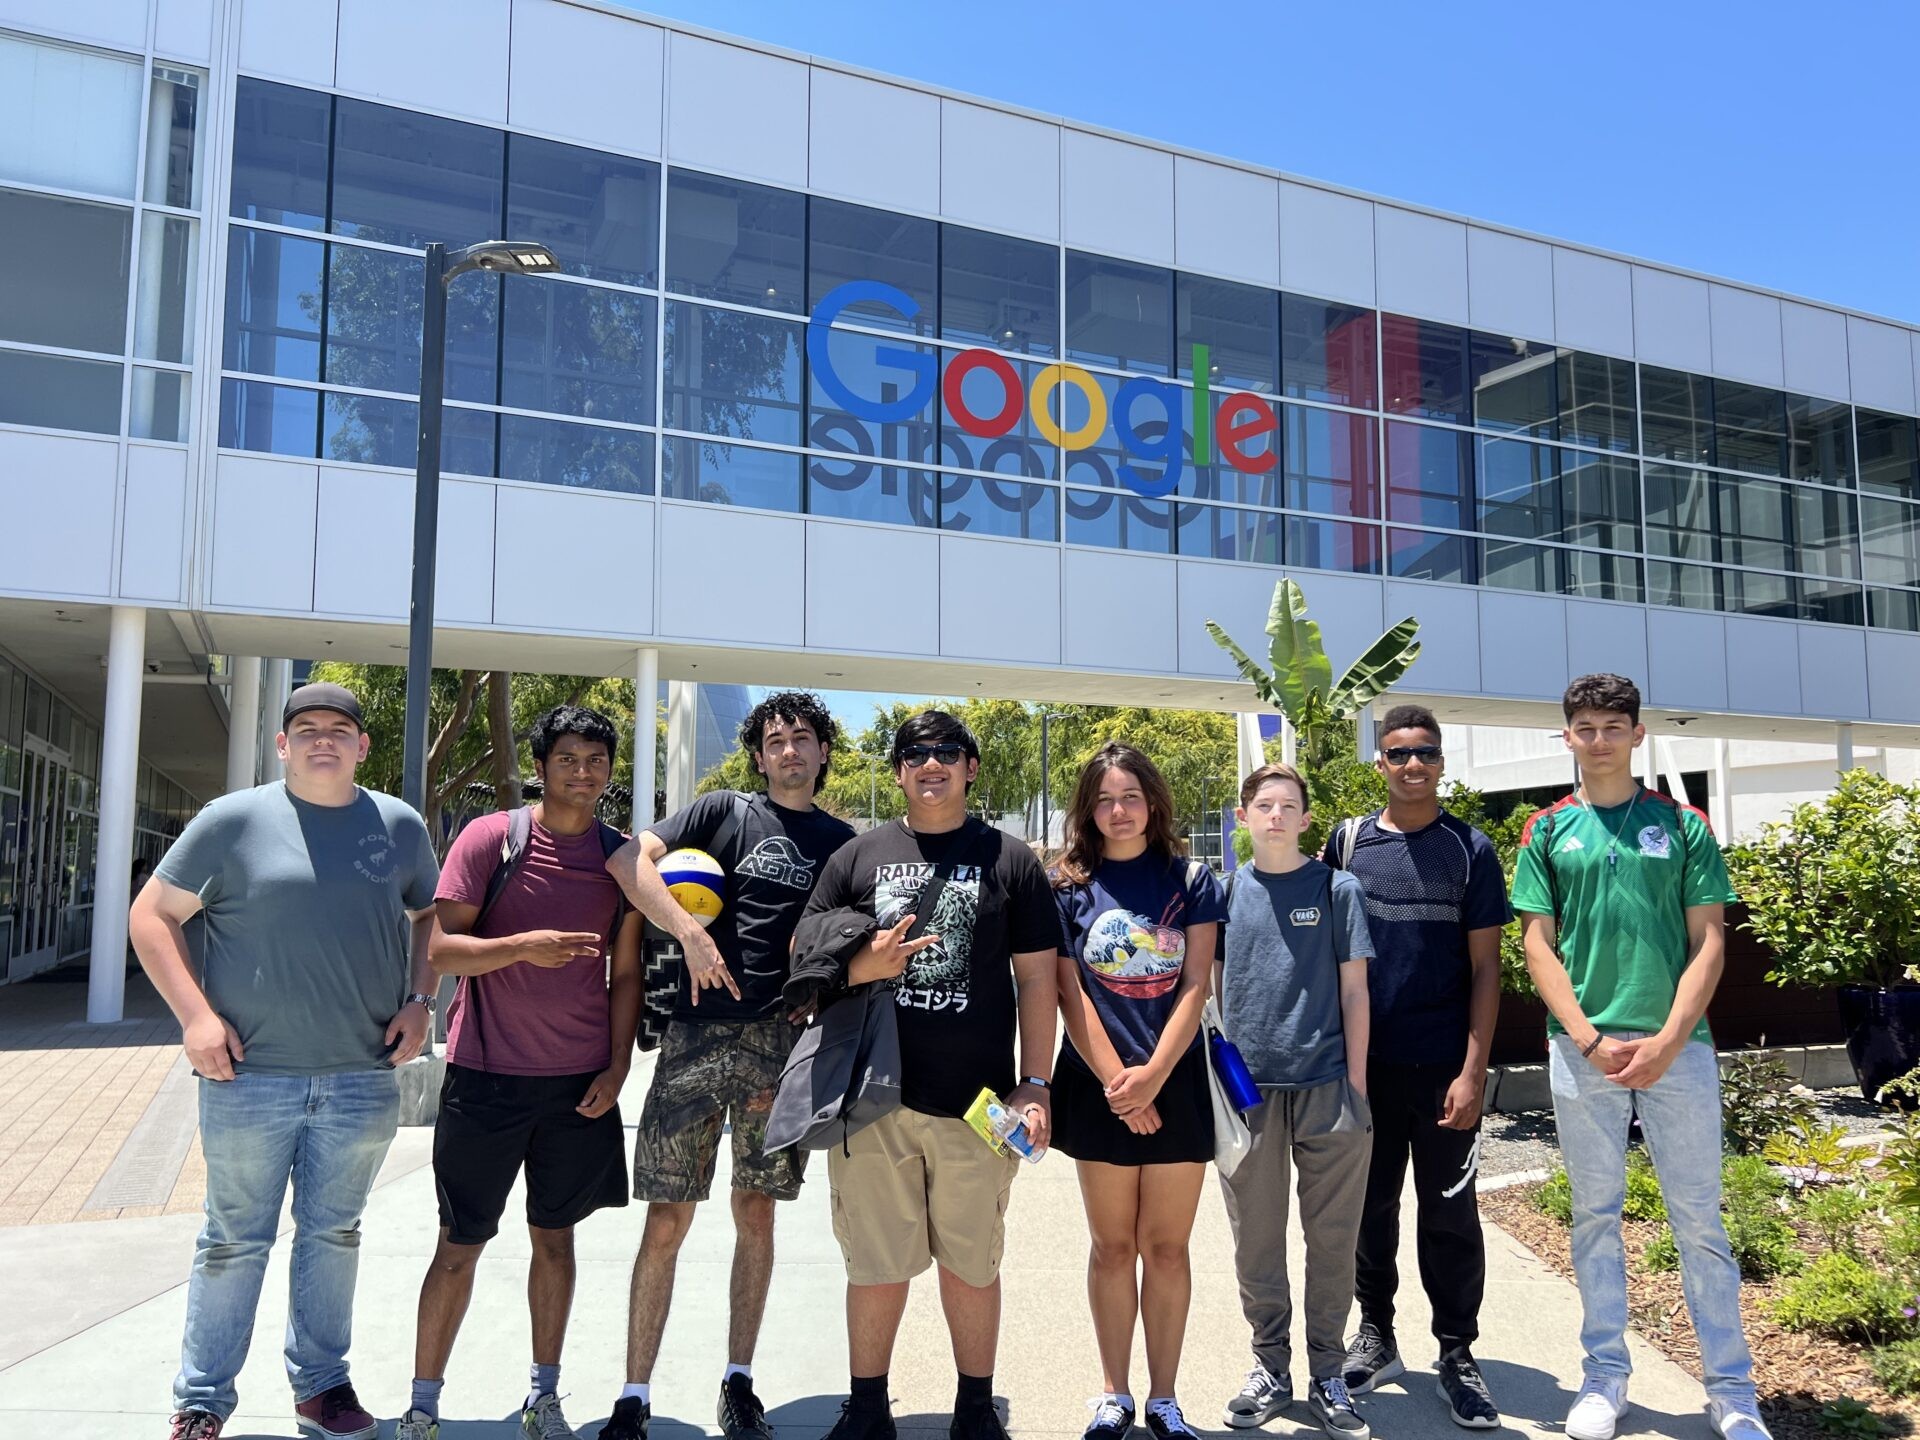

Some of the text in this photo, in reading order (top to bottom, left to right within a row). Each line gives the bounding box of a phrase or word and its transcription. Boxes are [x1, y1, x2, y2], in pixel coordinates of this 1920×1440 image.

[806, 280, 1279, 498] Google
[879, 863, 977, 883] RADZLA
[1296, 910, 1315, 920] VANS
